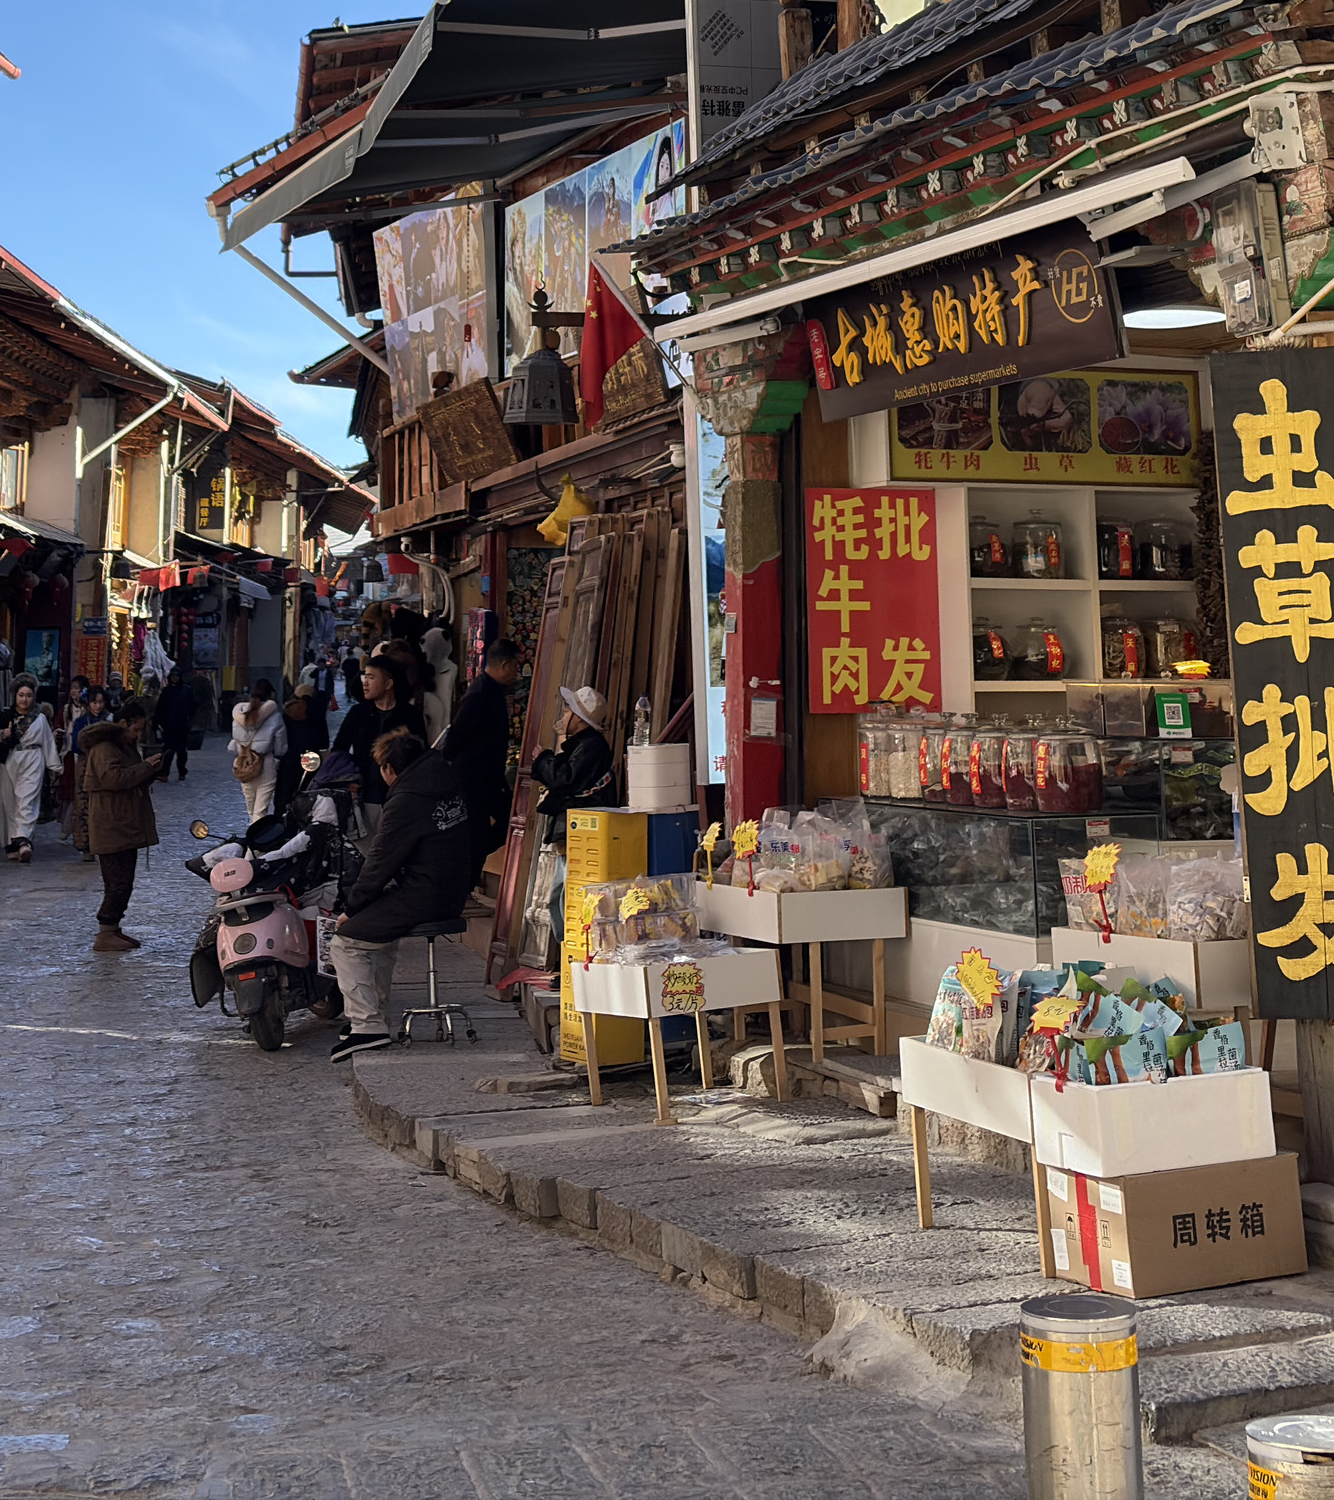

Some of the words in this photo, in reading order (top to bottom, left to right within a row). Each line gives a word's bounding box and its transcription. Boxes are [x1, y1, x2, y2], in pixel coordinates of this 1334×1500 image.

[832, 254, 1044, 388] 古城惠购特产
[894, 380, 918, 401] Ancient
[918, 378, 930, 397] city
[938, 373, 969, 394] purchase
[970, 362, 1018, 385] supermarkets
[914, 451, 982, 471] 牦牛肉
[1023, 454, 1075, 472] 虫草
[1115, 456, 1181, 475] 藏红花
[811, 493, 871, 706] 牦牛肉
[873, 494, 935, 704] 批发
[1172, 1202, 1266, 1249] 周转箱
